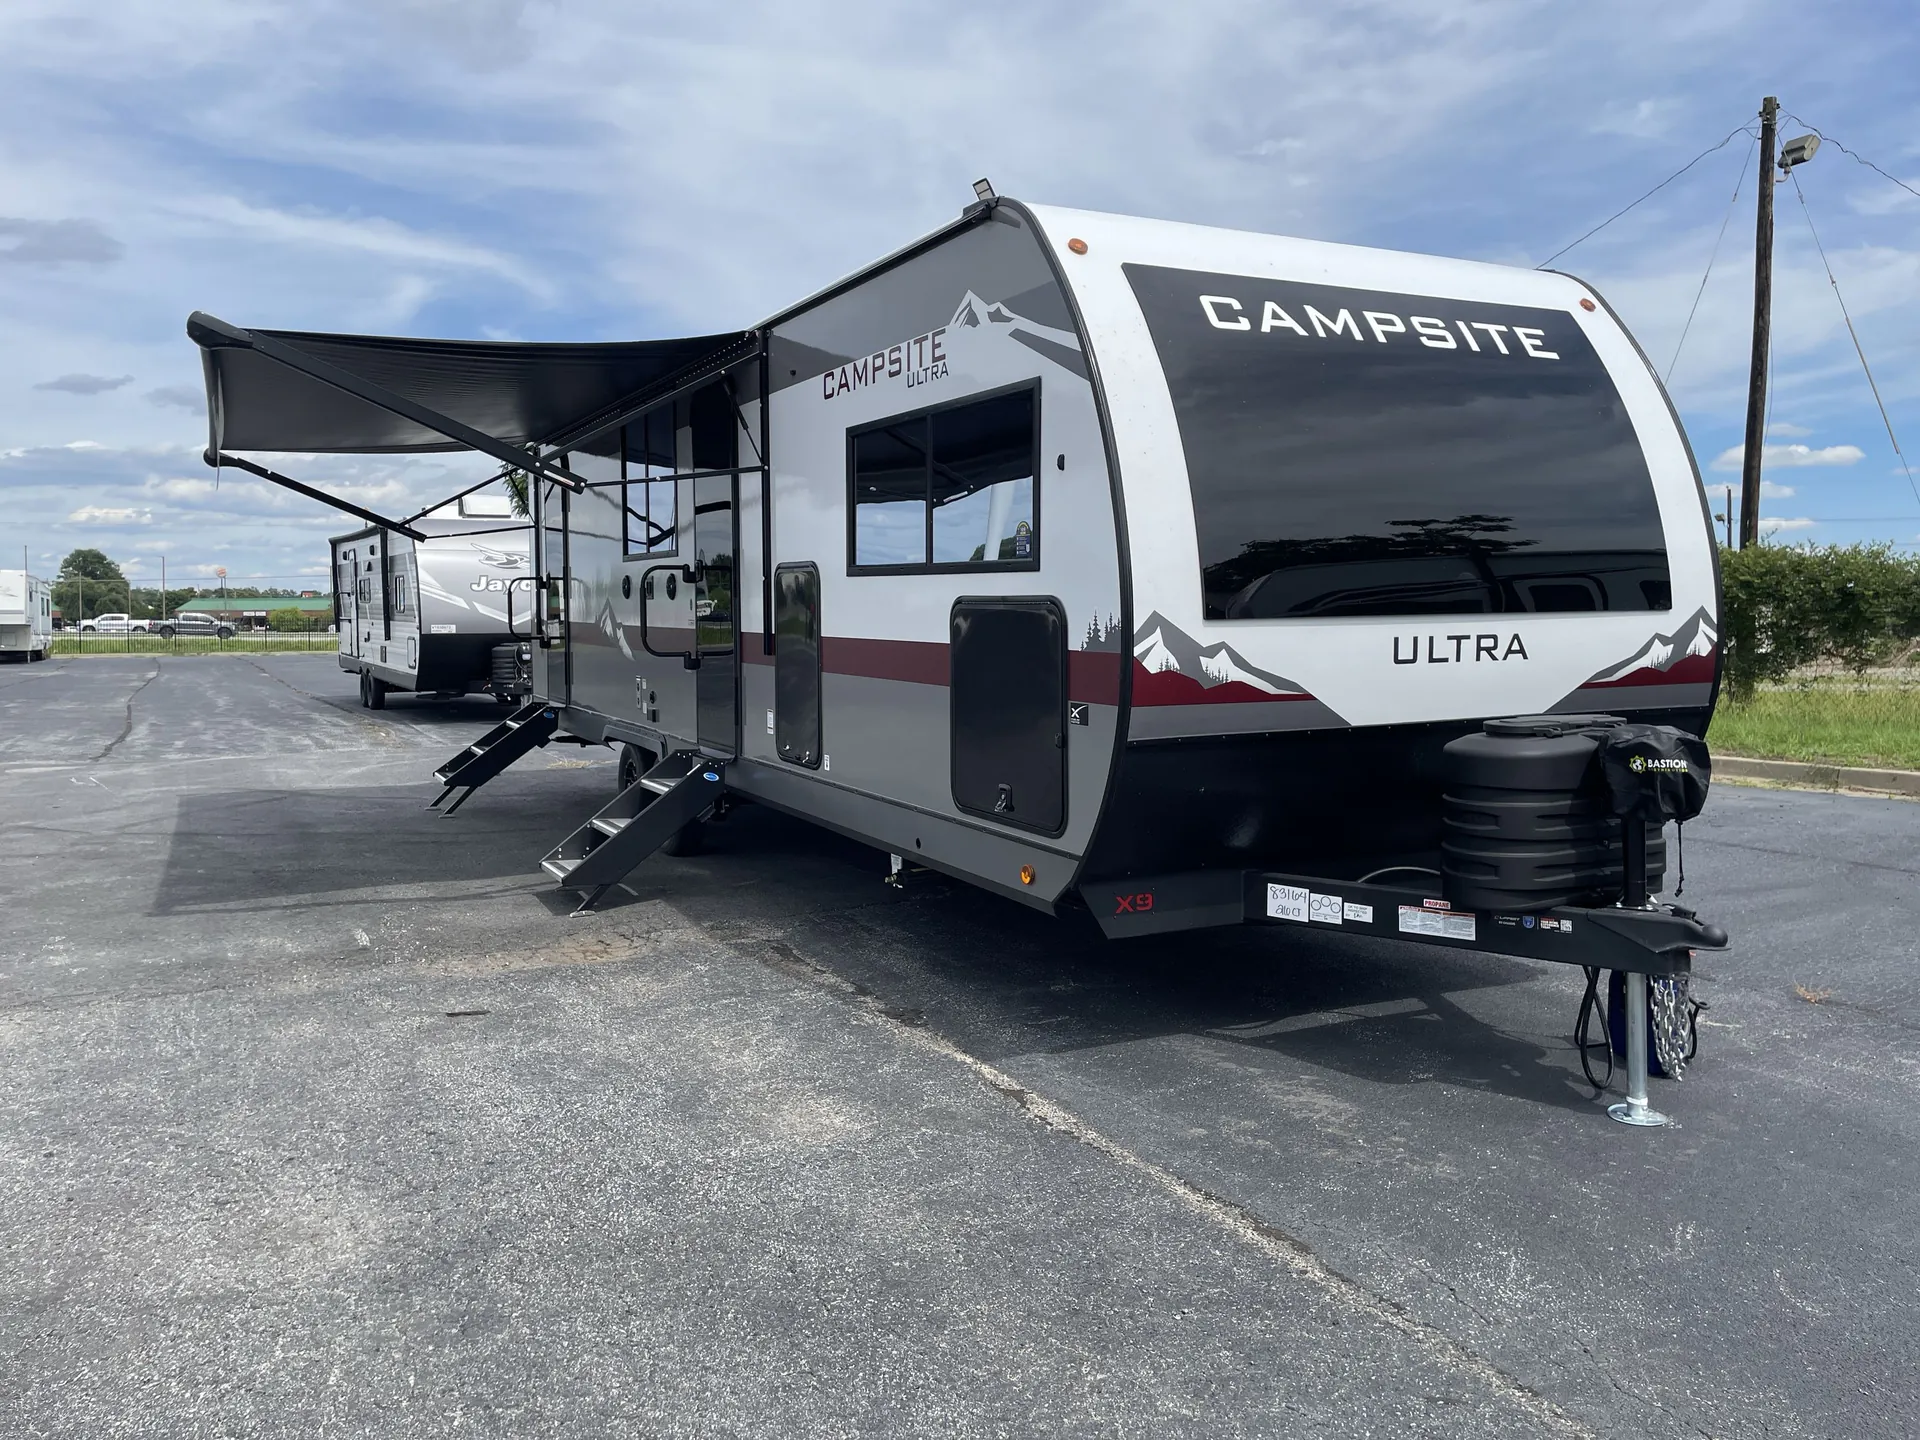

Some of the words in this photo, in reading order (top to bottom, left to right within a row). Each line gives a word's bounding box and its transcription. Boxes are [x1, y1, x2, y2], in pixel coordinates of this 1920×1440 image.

[1198, 294, 1561, 360] CAMPSITE
[823, 327, 947, 400] CAMPSITE
[906, 360, 949, 389] ULTRA
[470, 574, 531, 595] Jayc
[1393, 633, 1529, 665] ULTRA
[1647, 759, 1687, 769] BASTION
[1115, 893, 1153, 913] X9
[1269, 885, 1306, 903] 83164
[1424, 900, 1450, 909] PROPANE
